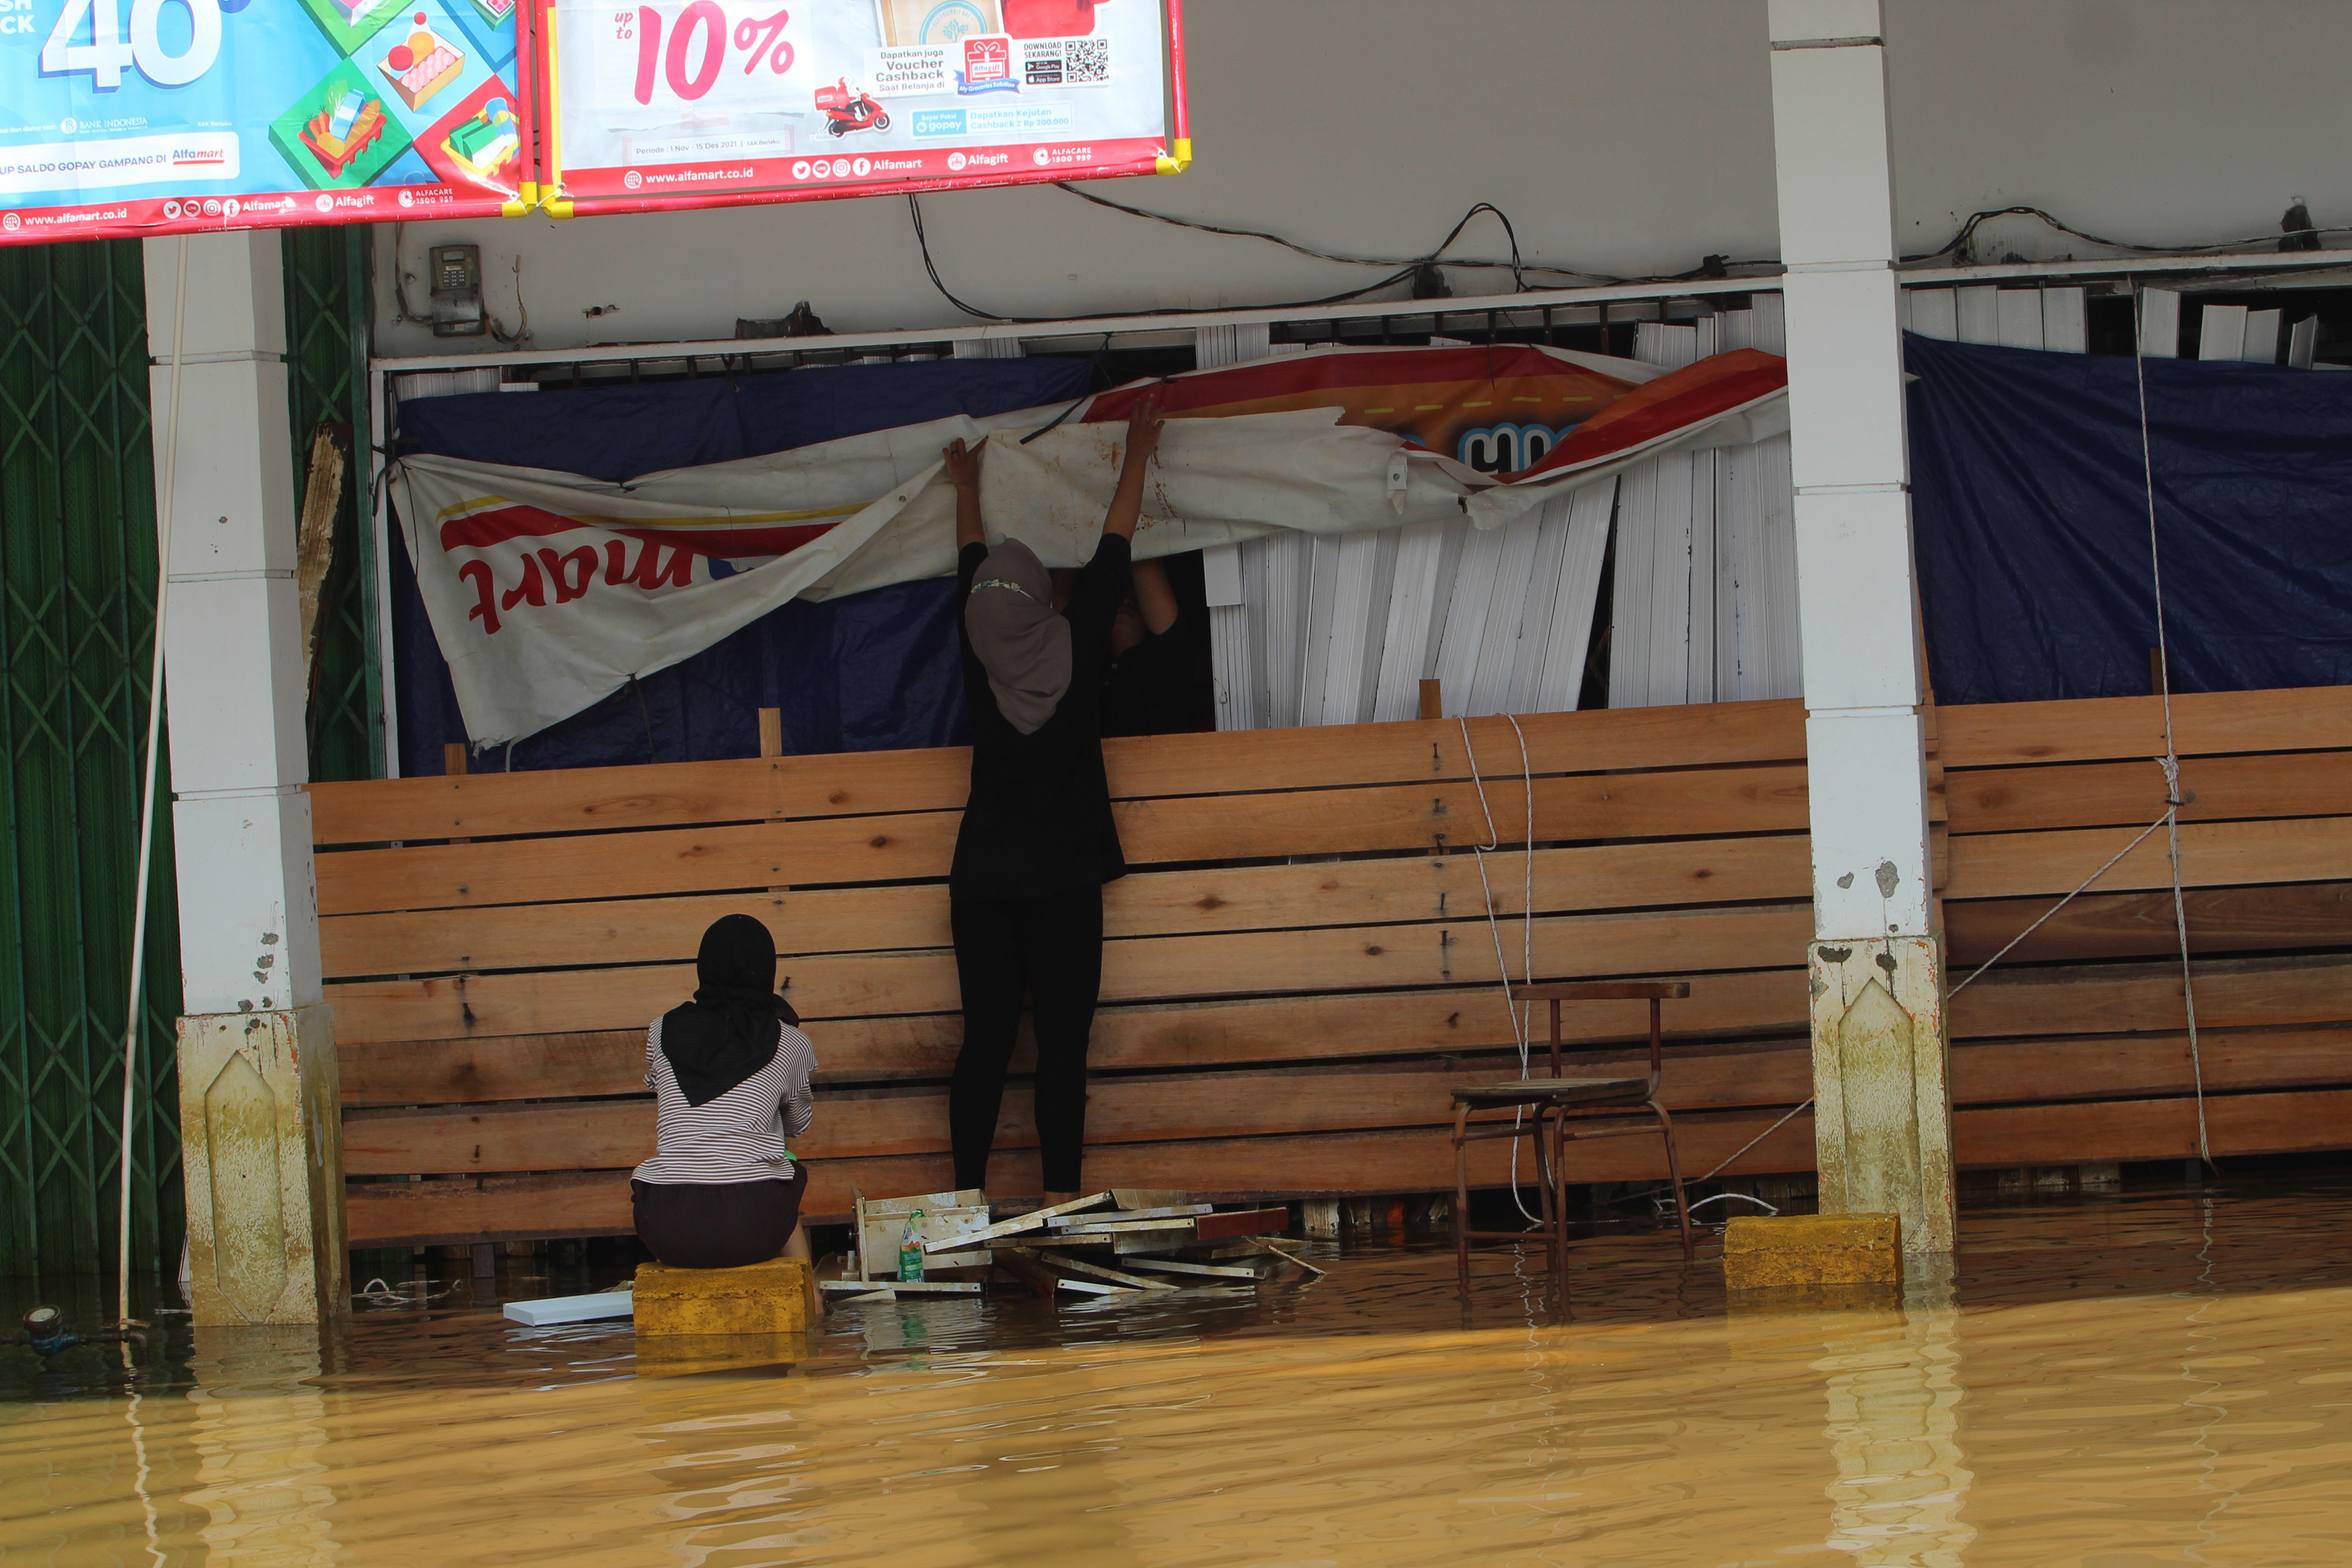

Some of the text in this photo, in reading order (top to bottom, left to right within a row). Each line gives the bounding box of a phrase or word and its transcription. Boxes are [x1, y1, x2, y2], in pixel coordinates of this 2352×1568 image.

[1, 15, 36, 35] CK
[614, 12, 633, 27] up
[616, 27, 633, 39] to
[39, 0, 222, 92] 40
[1024, 42, 1061, 51] DOWNLOAD
[881, 49, 944, 60] Dapatkan juga
[1024, 50, 1061, 58] SEKARANG!
[886, 59, 944, 70] Voucher
[974, 63, 1001, 73] Alfagift
[876, 69, 944, 82] Cashback
[901, 82, 934, 91] Belanja
[968, 82, 993, 92] Groceries
[971, 108, 1051, 121] Dapatkan Kejutan
[80, 117, 148, 129] BANK INDONESIA
[928, 121, 962, 132] gopay
[971, 120, 1014, 129] Cashback
[172, 149, 225, 160] Alfamart
[636, 145, 664, 155] Periode
[1052, 146, 1091, 155] ALFACARE
[968, 152, 1008, 167] Alfagift
[1052, 153, 1091, 163] 1500 959
[0, 154, 166, 175] UP SALDO GOPAY GAMPANG DI
[873, 158, 922, 171] Alfamart
[646, 168, 753, 183] www.alfamart.co.id
[416, 188, 453, 196] ALFACARE
[243, 196, 295, 211] Alfamar
[336, 195, 375, 208] Alfagift
[416, 196, 437, 205] 1500
[25, 208, 127, 226] www.alfamart.co.id
